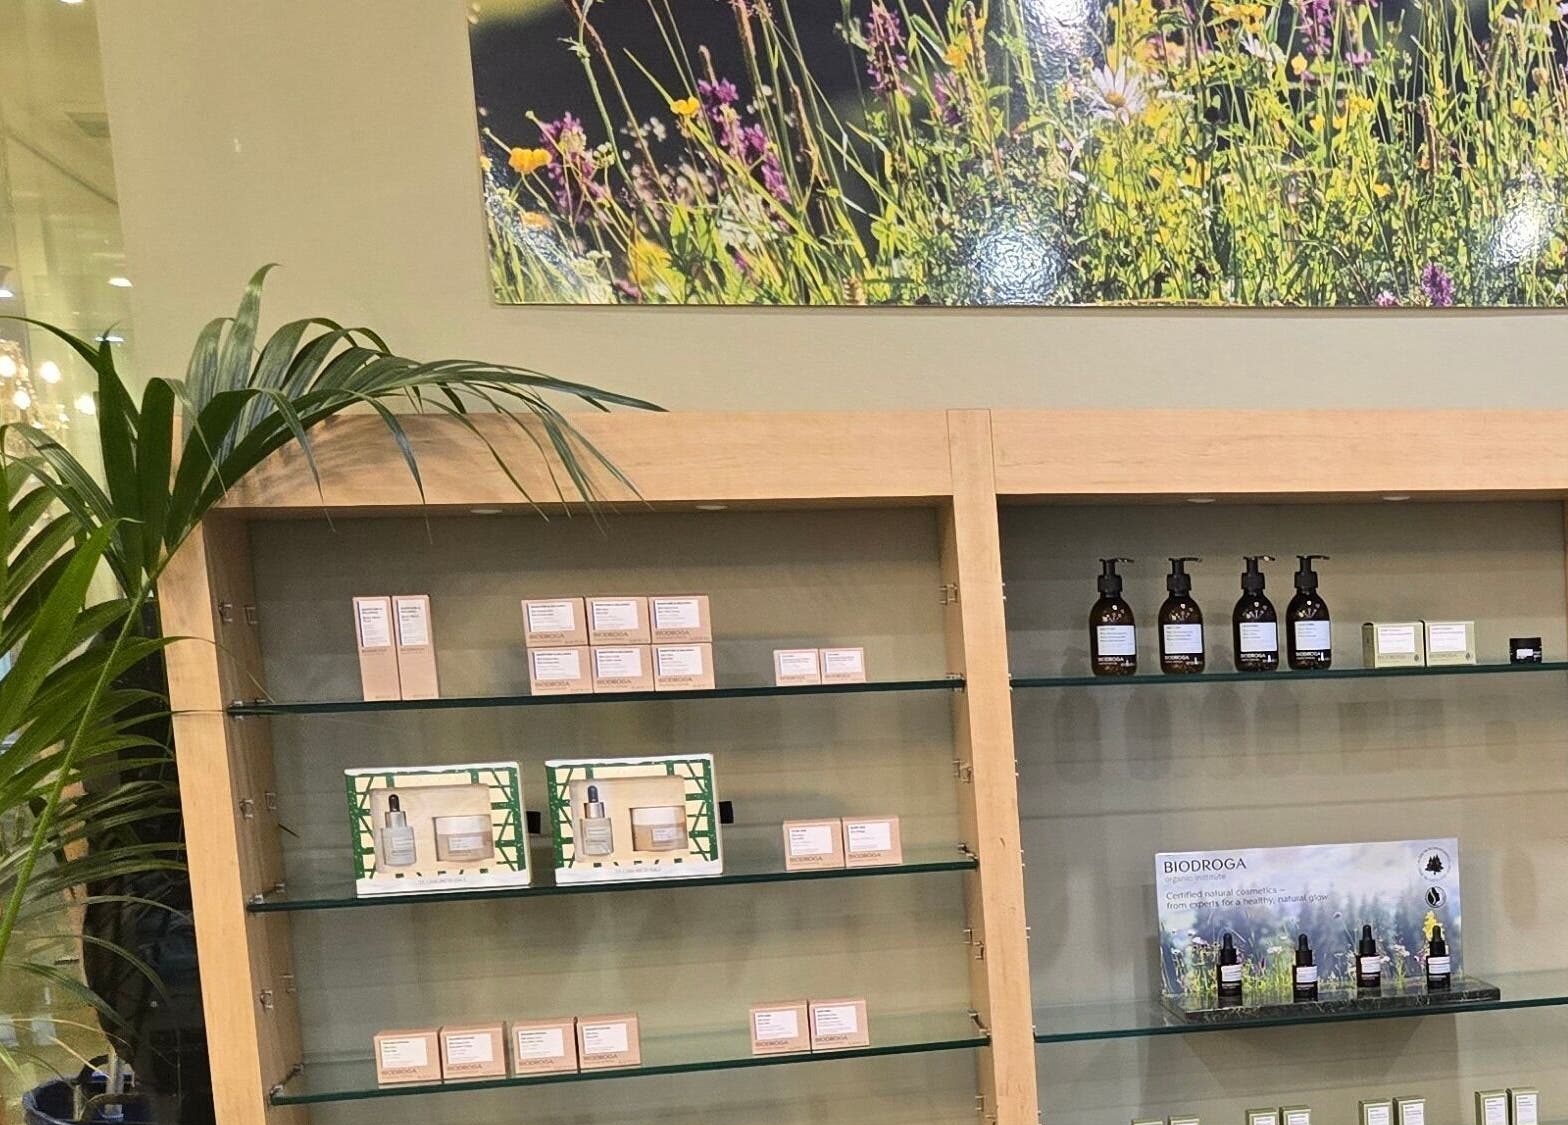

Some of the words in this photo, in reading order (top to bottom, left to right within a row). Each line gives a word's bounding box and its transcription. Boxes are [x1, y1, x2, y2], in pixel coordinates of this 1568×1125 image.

[1164, 858, 1247, 873] BIODROGA
[1166, 890, 1202, 899] Certified
[1204, 889, 1233, 897] natural
[1236, 887, 1277, 896] cosmetics
[1166, 901, 1188, 910] from
[1189, 900, 1219, 911] experts
[1221, 899, 1233, 907] for
[1243, 897, 1276, 907] healthy,
[1278, 894, 1307, 903] natural
[1308, 893, 1329, 902] glow
